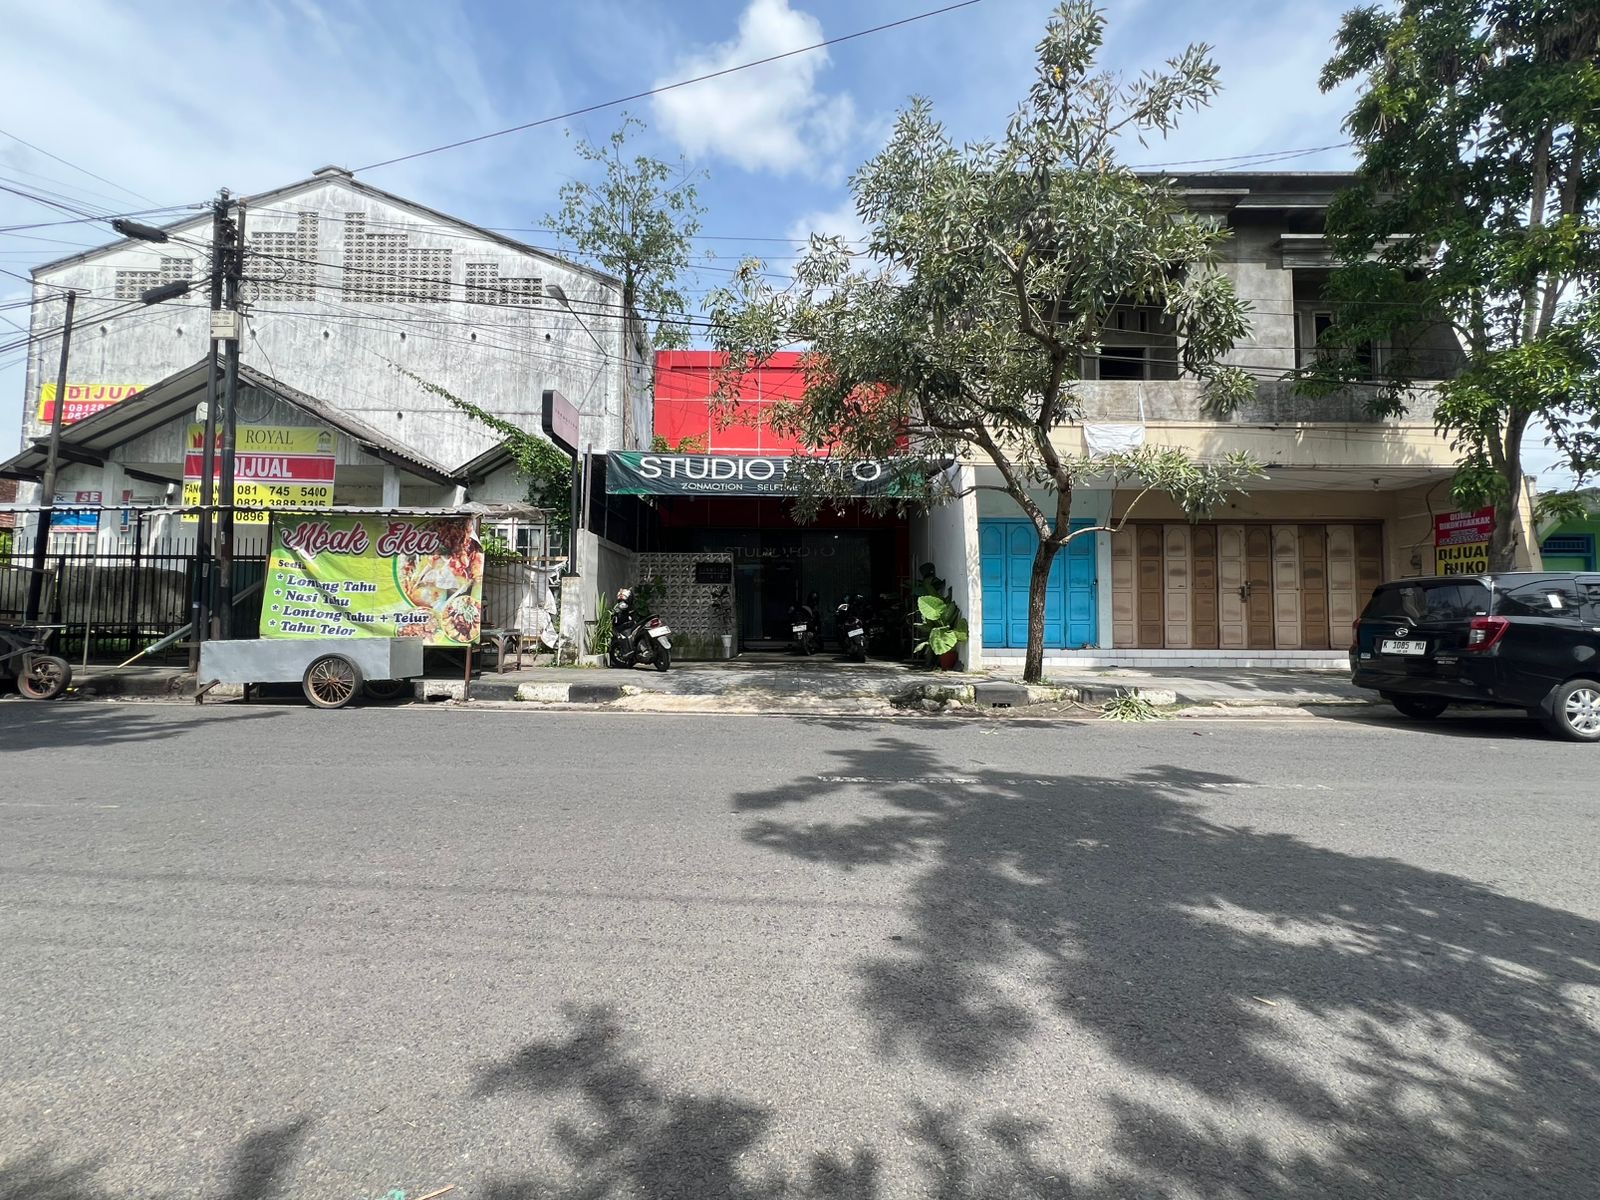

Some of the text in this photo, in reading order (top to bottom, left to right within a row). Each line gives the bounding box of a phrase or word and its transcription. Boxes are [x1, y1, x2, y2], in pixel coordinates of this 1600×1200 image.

[69, 387, 140, 399] DIJUA
[246, 430, 293, 445] ROYAL
[639, 456, 775, 480] STUDIO
[237, 485, 257, 495] 081
[269, 486, 290, 497] 745
[681, 482, 743, 491] ZONMOTION
[280, 519, 440, 560] Mbak Eka
[344, 581, 377, 592] Tahu
[285, 590, 319, 603] Nasi
[282, 605, 342, 622] Lontong
[344, 611, 375, 623] Tahu
[393, 612, 429, 623] Telur
[281, 620, 356, 636] Tahu Telor
